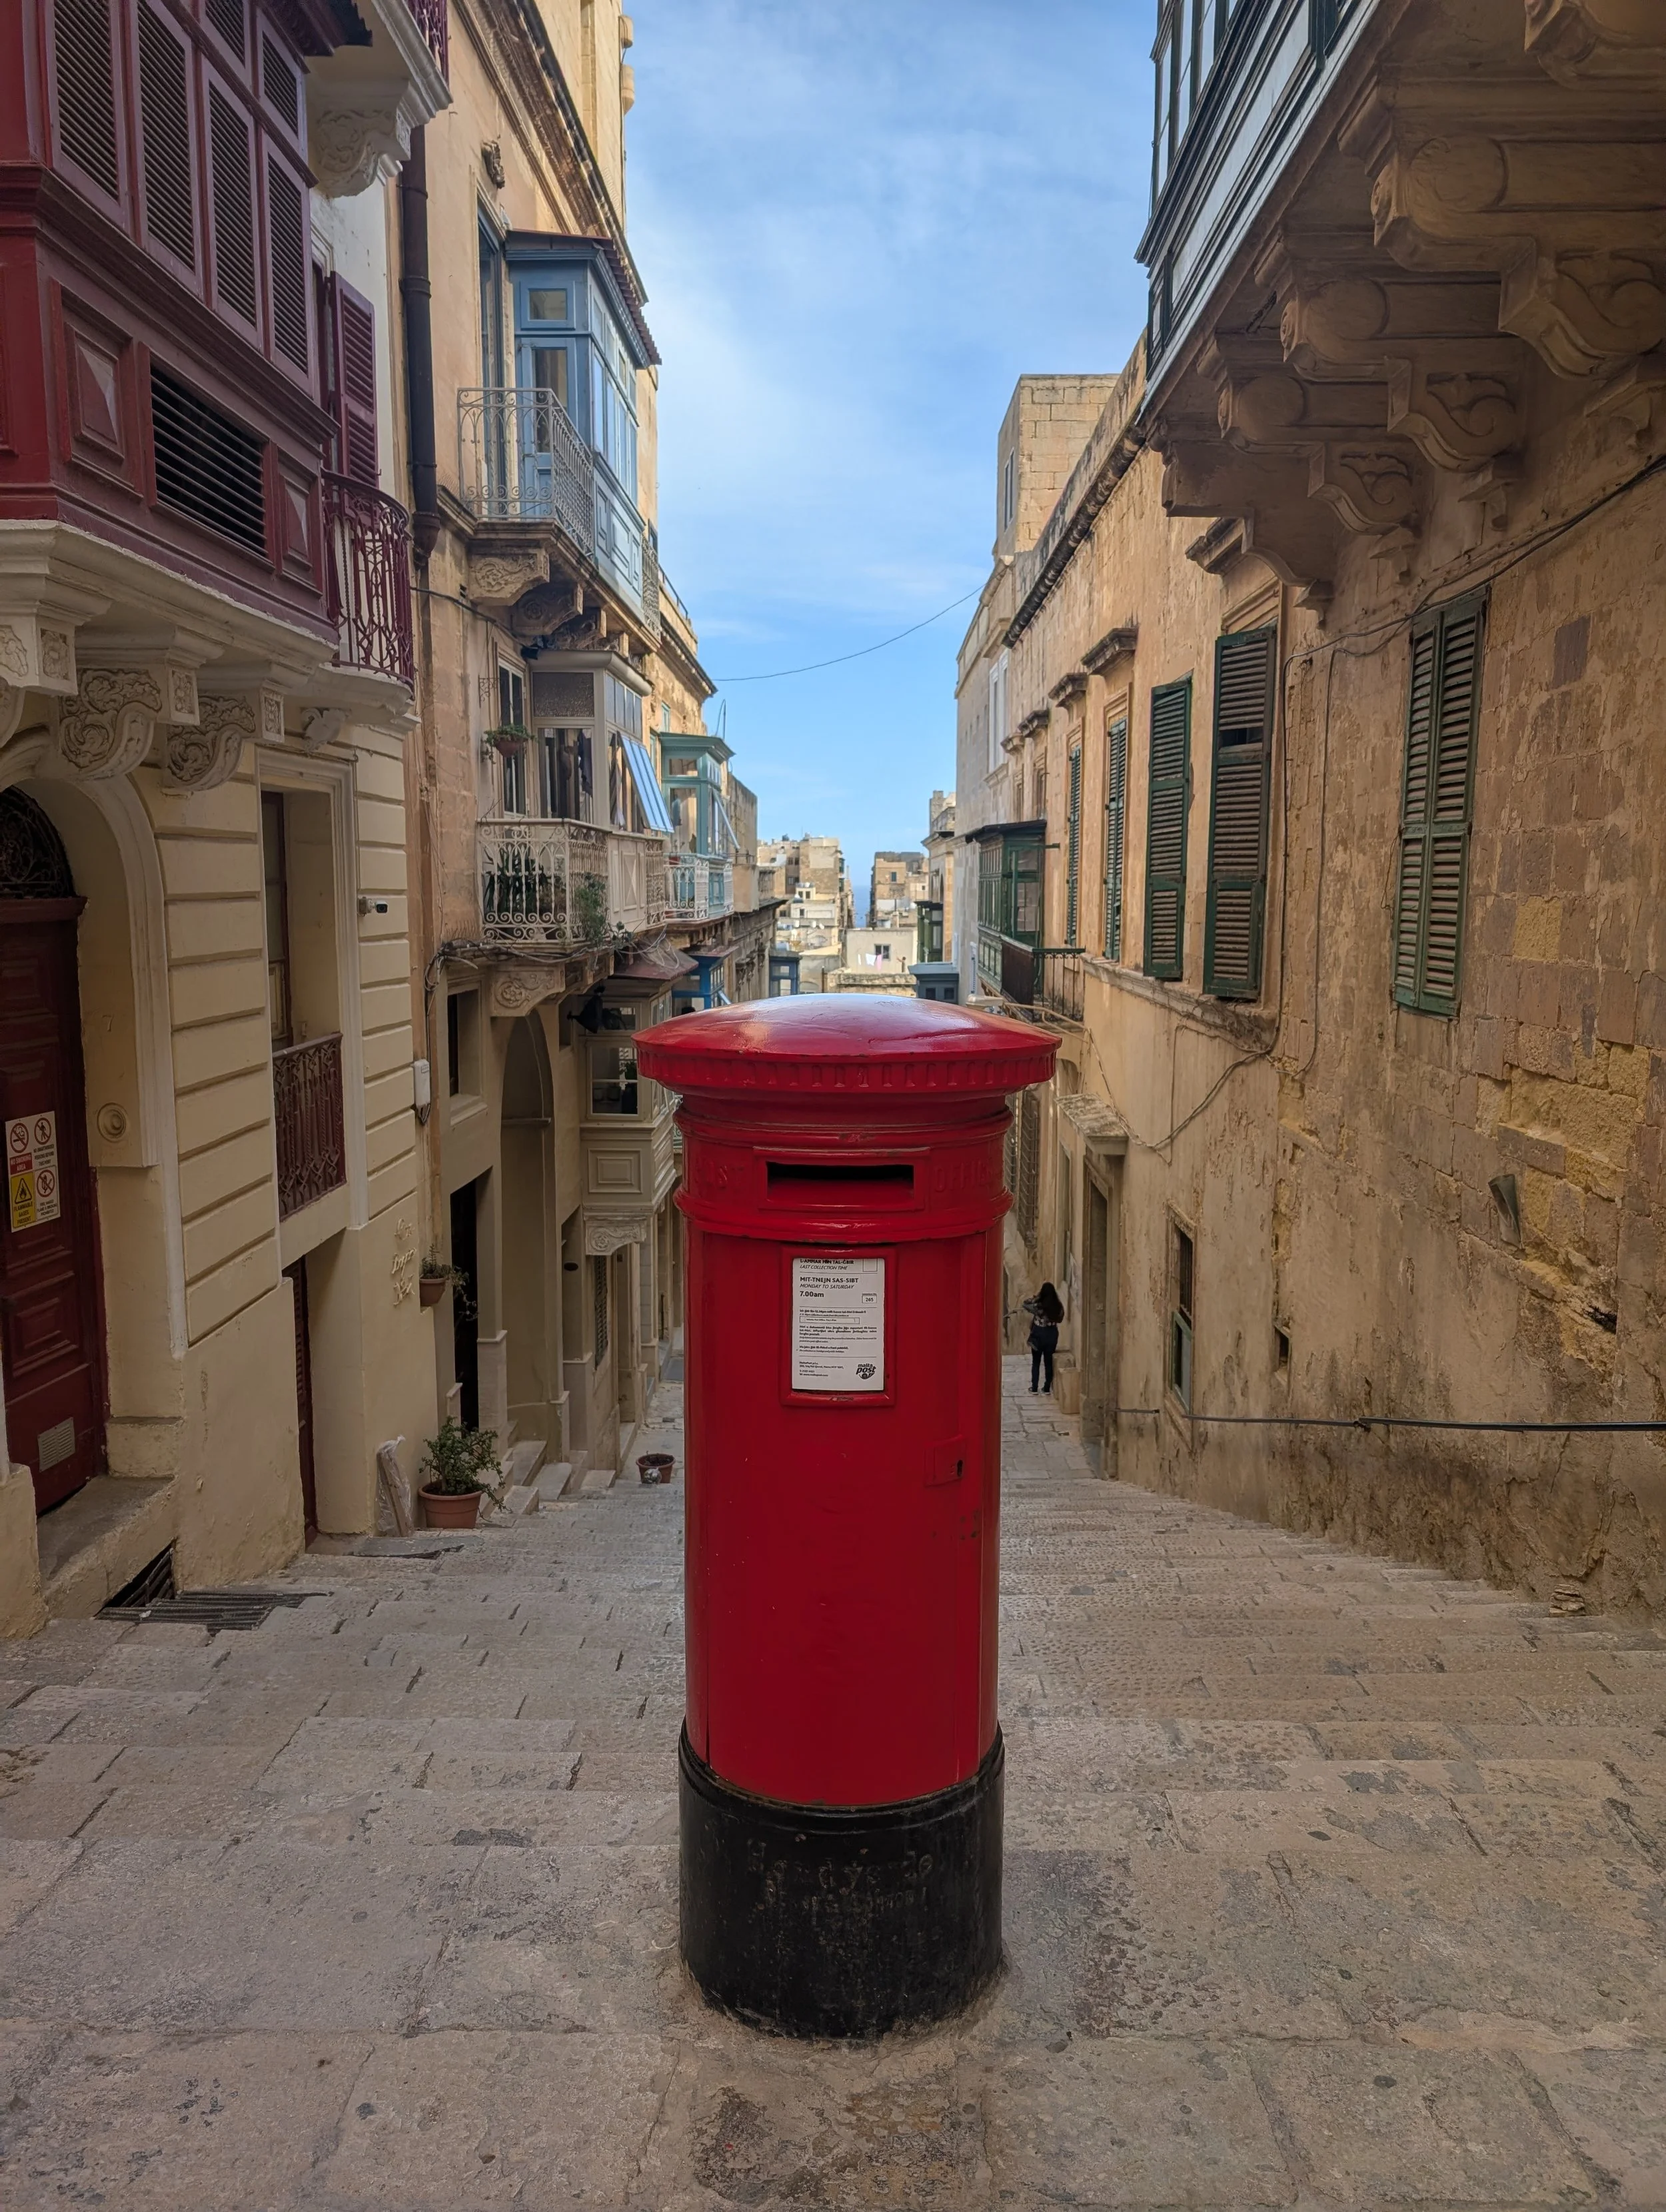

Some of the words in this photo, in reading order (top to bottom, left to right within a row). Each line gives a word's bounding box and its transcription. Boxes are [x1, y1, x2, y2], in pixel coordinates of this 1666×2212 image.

[102, 1014, 114, 1033] 7
[15, 1154, 32, 1164] SMOKING
[856, 1366, 876, 1375] post
